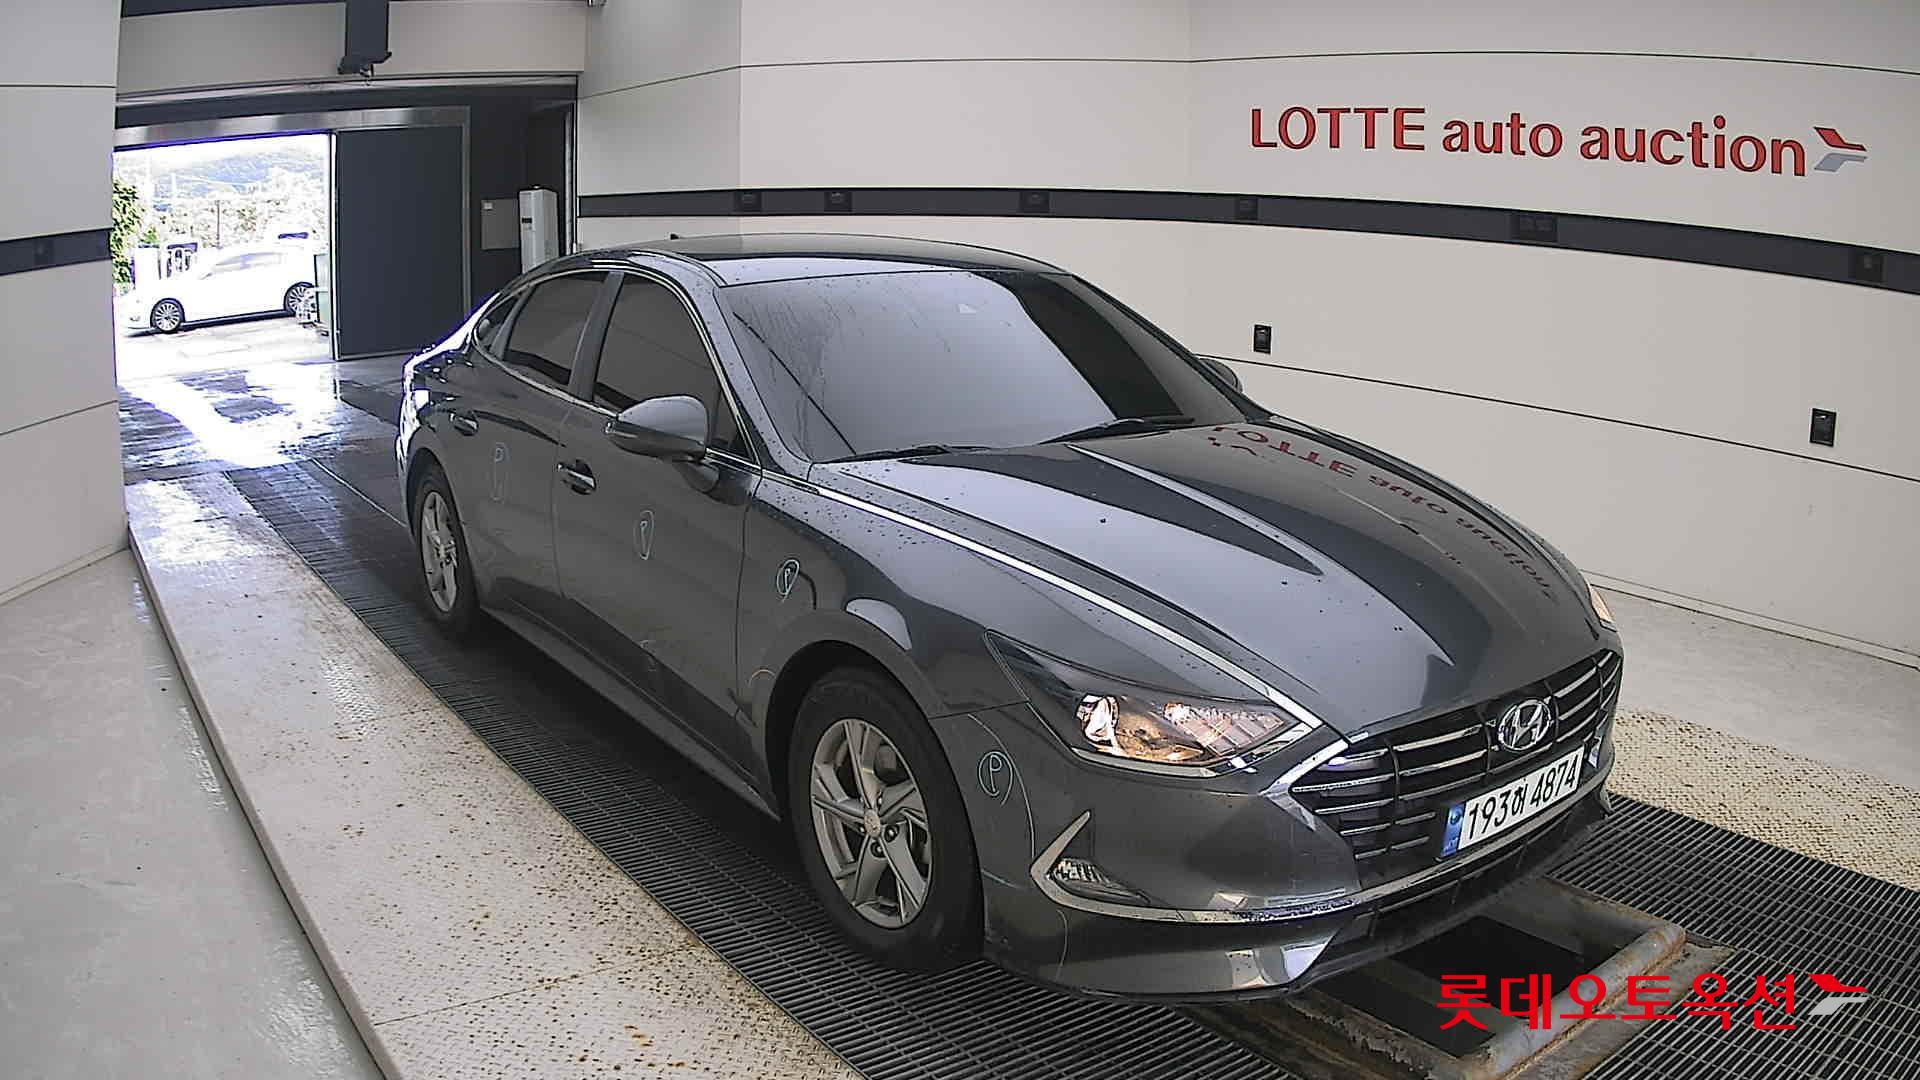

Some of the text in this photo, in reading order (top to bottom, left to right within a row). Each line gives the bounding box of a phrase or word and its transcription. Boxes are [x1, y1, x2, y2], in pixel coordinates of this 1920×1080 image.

[1251, 106, 1806, 177] LOTTE auto auction
[1468, 755, 1578, 840] 193허 4874
